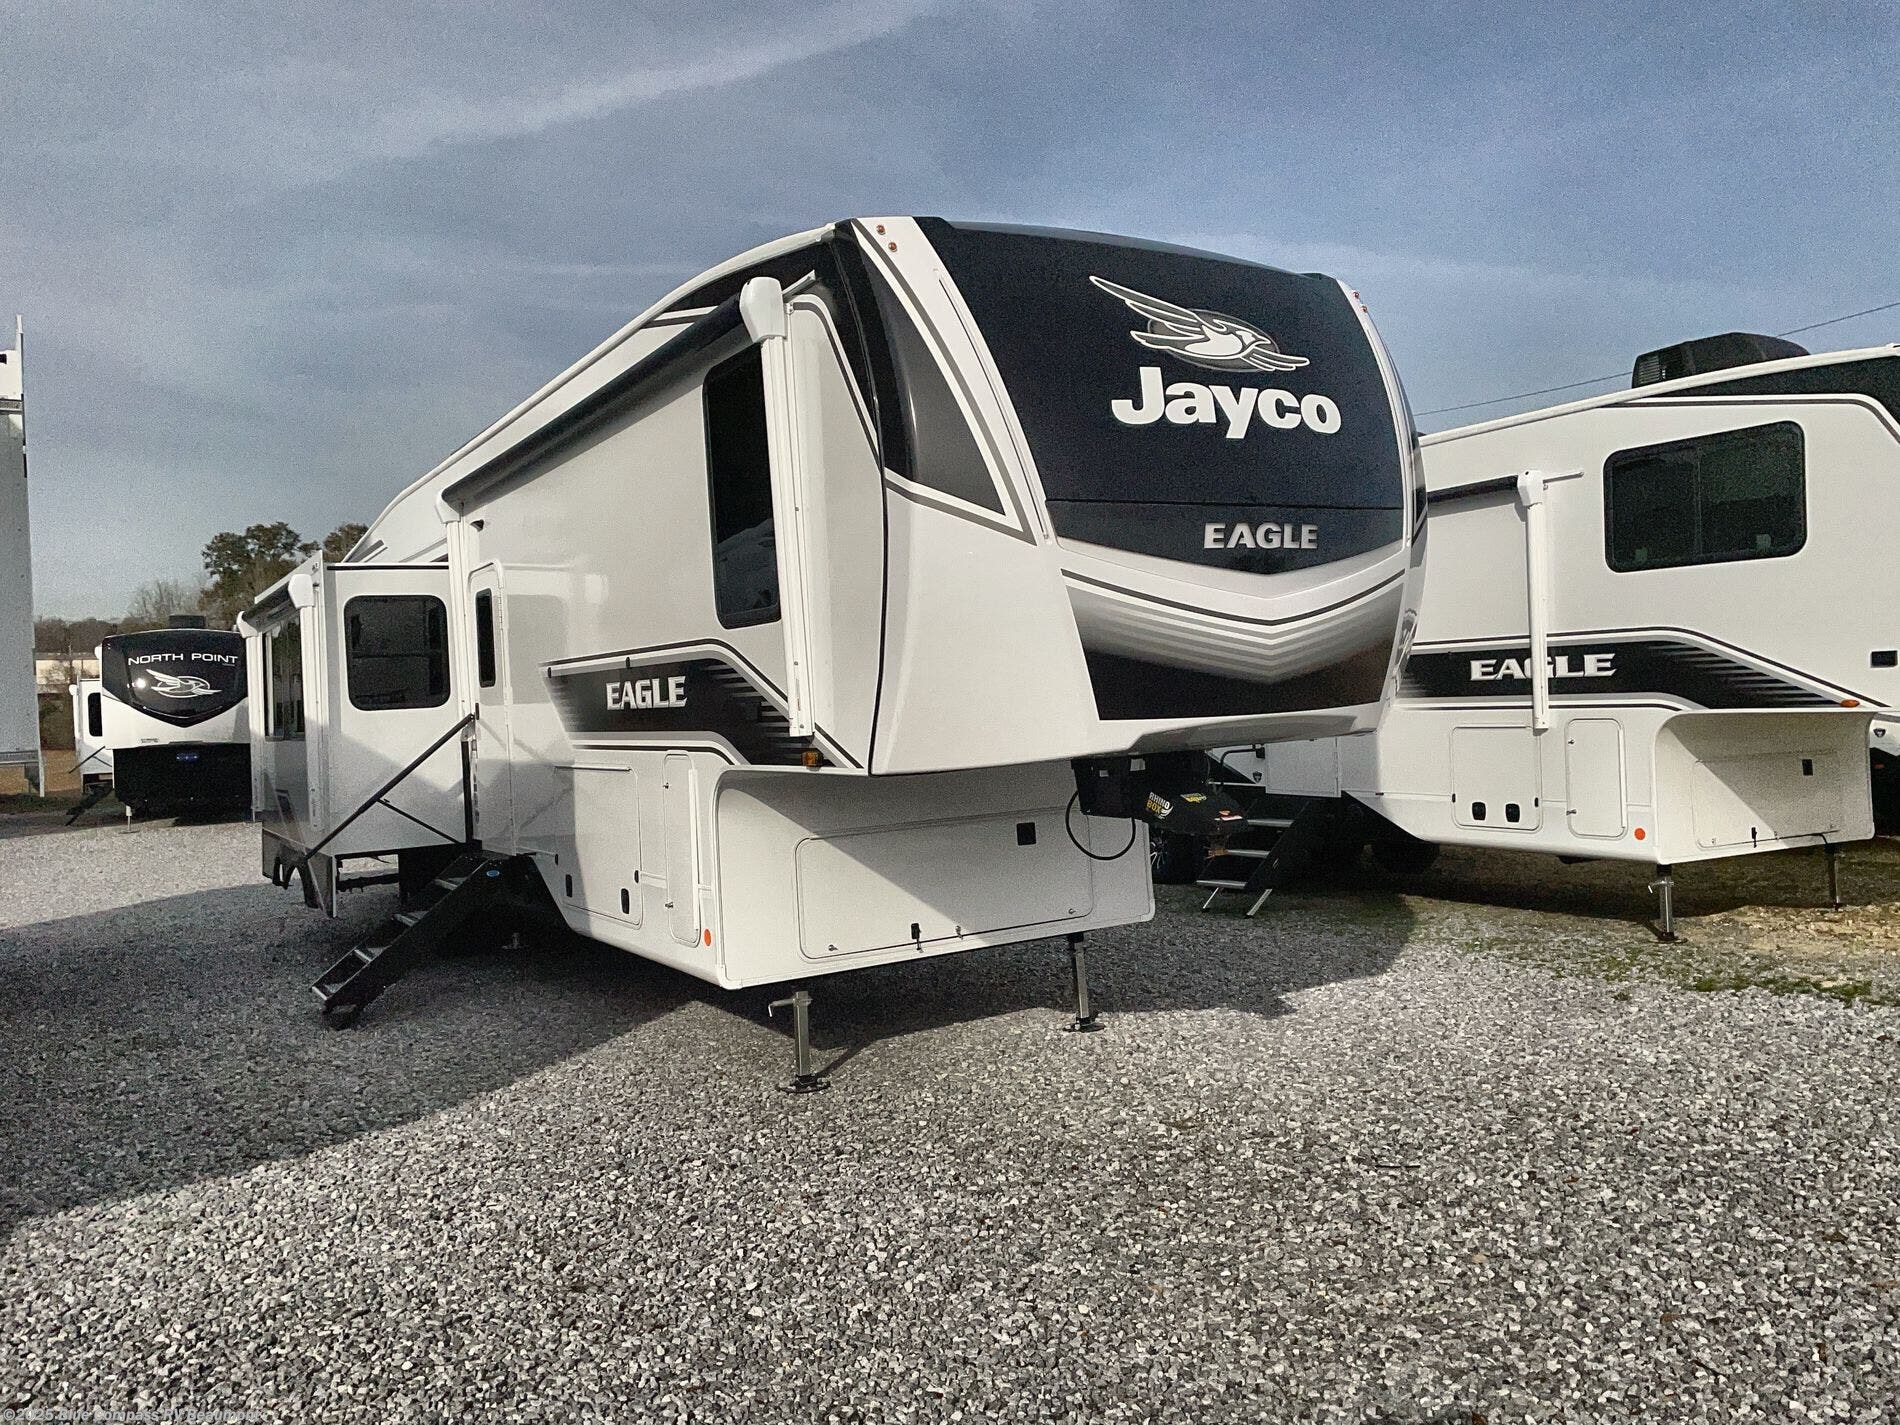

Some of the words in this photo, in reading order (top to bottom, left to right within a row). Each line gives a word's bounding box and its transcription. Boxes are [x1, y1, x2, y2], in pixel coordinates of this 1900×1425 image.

[1111, 366, 1341, 439] Jayco
[1203, 522, 1318, 550] EAGLE
[128, 653, 184, 666] NORTH
[191, 653, 239, 664] POINT
[606, 675, 688, 711] EAGLE
[1147, 799, 1161, 813] BOX
[1149, 791, 1170, 810] RHINO
